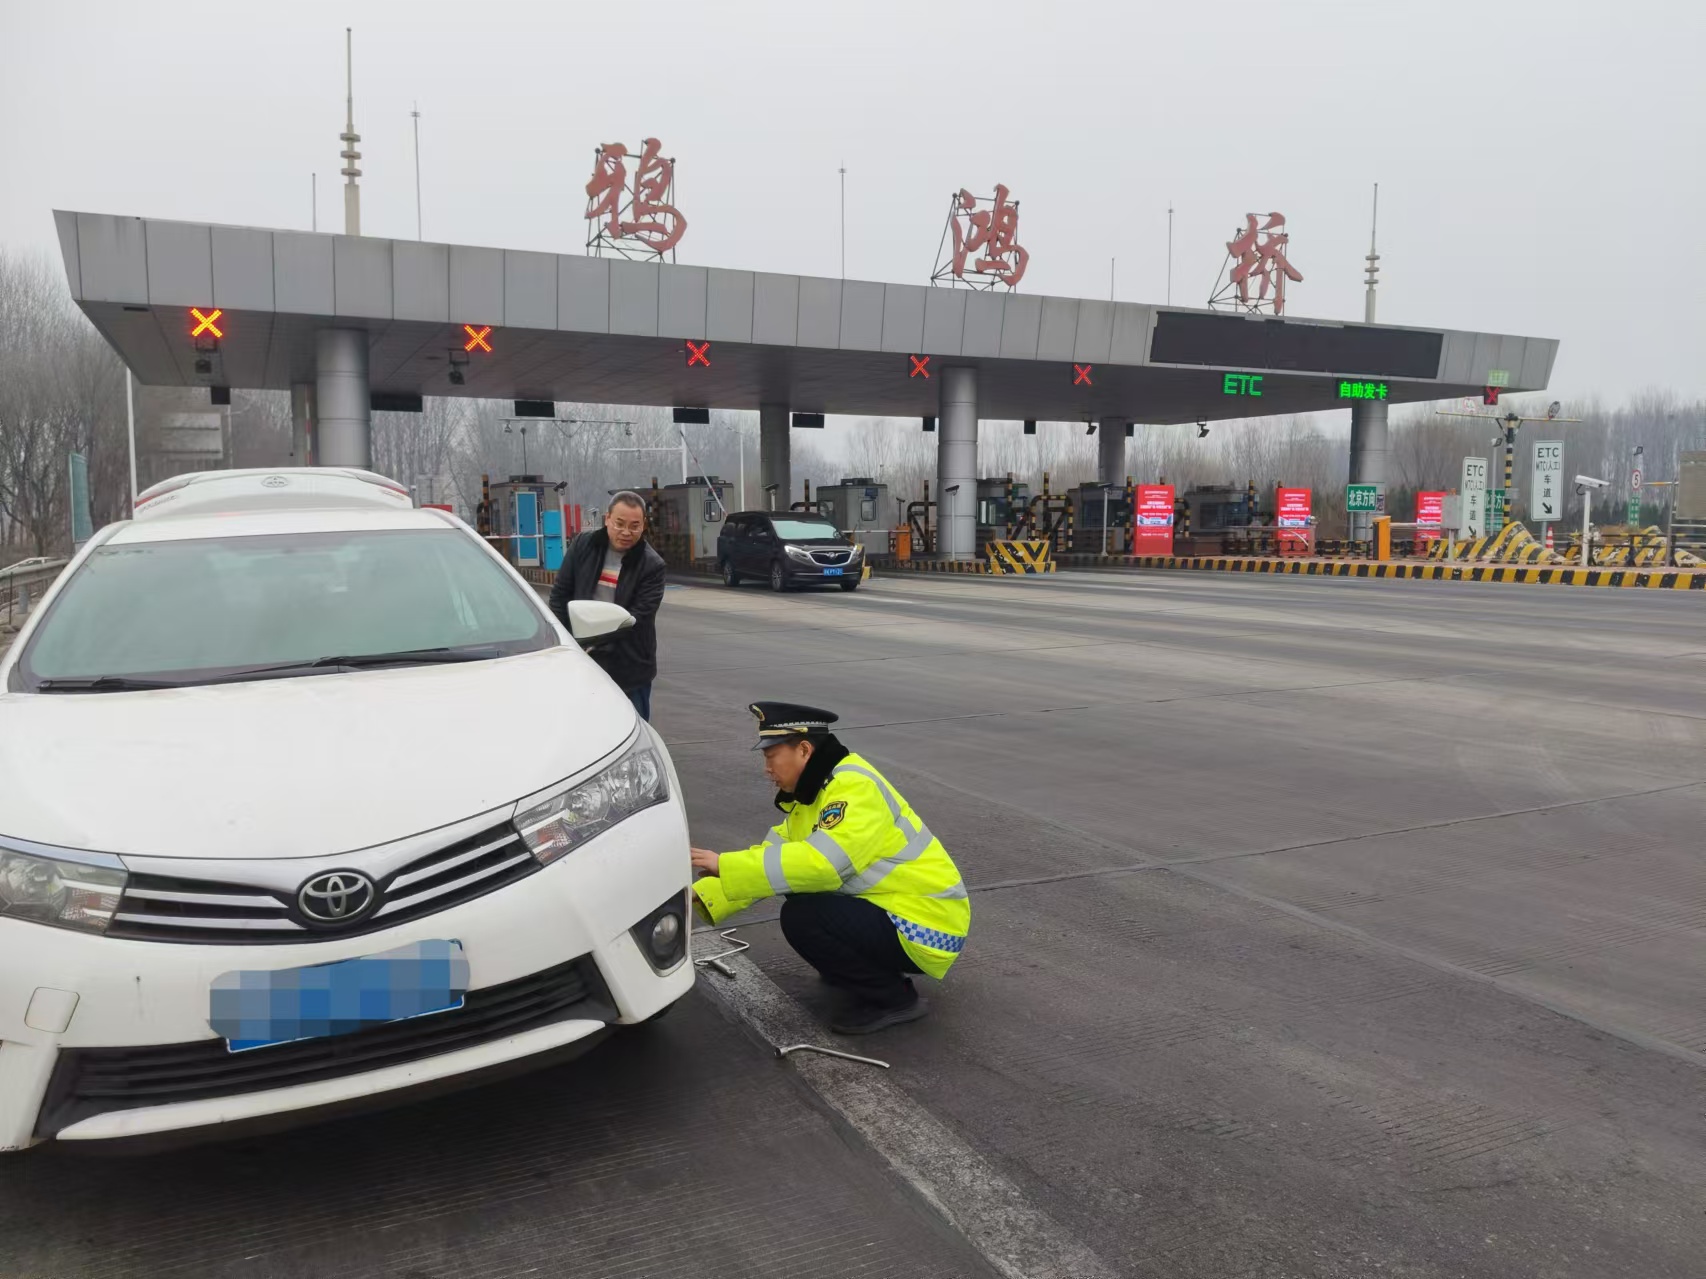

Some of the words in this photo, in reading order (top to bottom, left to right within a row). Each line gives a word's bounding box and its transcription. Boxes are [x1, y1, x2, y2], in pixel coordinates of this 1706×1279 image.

[1223, 373, 1263, 396] ETC
[1339, 381, 1388, 400] 自助发卡
[1537, 447, 1560, 459] ETC
[1466, 464, 1484, 477] ETC
[1543, 474, 1553, 498] 车道
[1348, 489, 1376, 507] 北京方向
